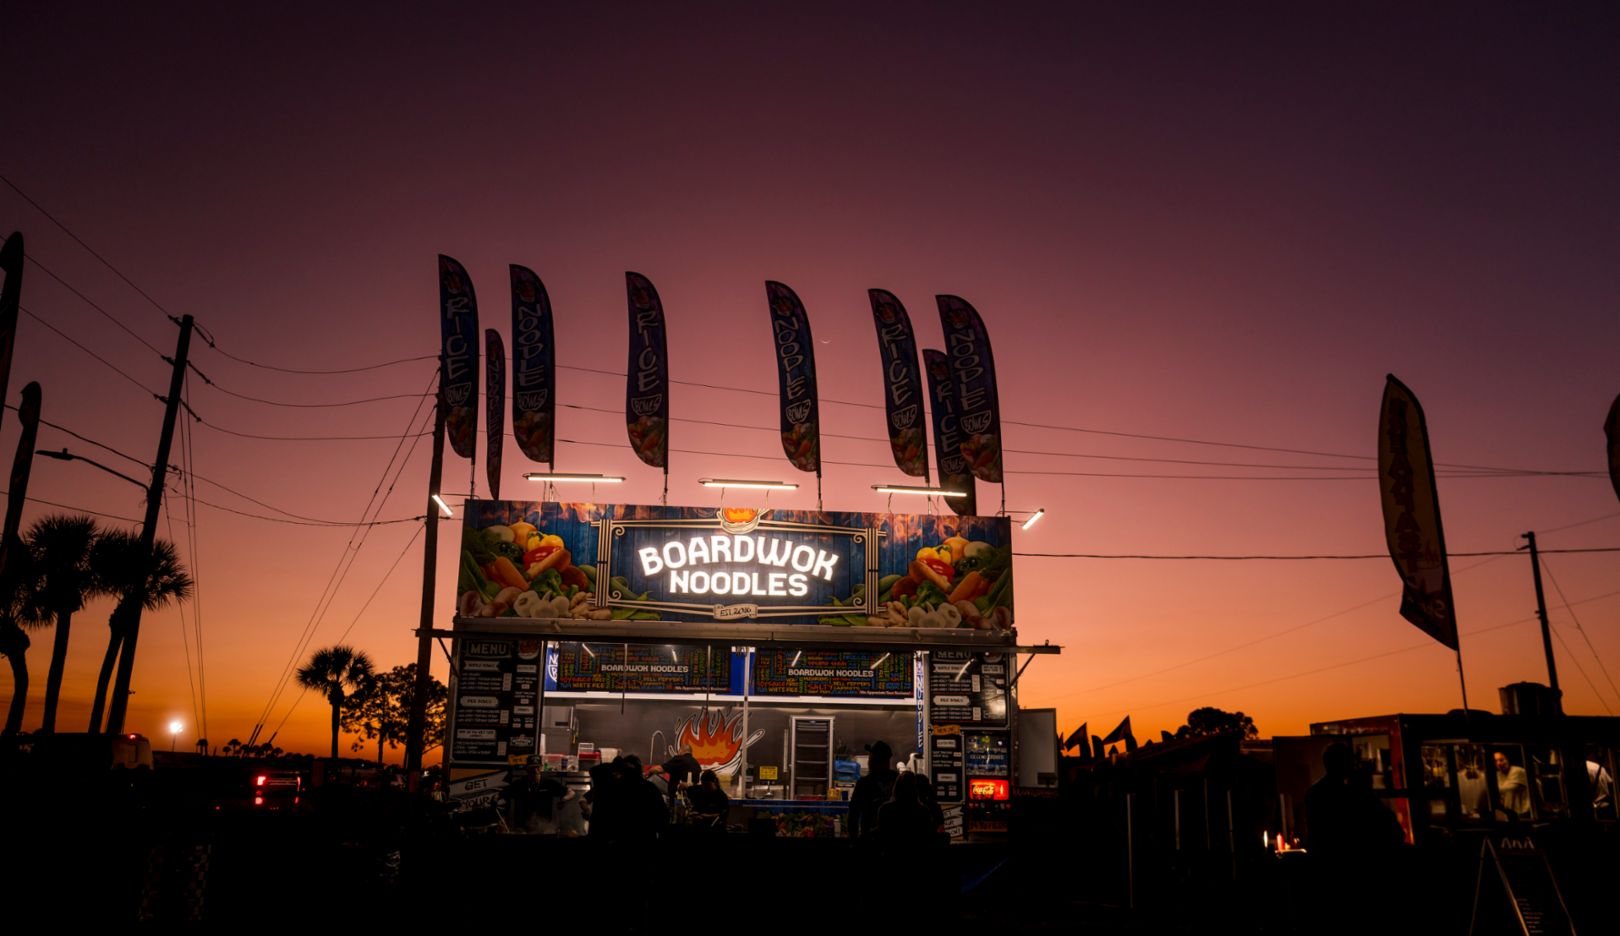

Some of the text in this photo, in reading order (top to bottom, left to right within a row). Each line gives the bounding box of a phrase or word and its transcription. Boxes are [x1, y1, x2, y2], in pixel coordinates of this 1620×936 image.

[446, 298, 470, 381] RICE
[517, 303, 546, 386] NOODLE
[637, 309, 659, 392] RICE
[775, 318, 804, 400] NOODLE
[881, 326, 911, 406] RICE
[952, 331, 985, 411] NOODLE
[936, 381, 960, 452] RICE
[638, 535, 839, 581] BOARDWOK
[669, 570, 808, 596] NOODLES
[470, 643, 506, 655] MENU
[601, 664, 688, 673] BOARDWOK NOODLES
[788, 668, 874, 677] BOARDWOK NOODLES
[937, 651, 971, 659] MENU
[465, 779, 487, 791] GET
